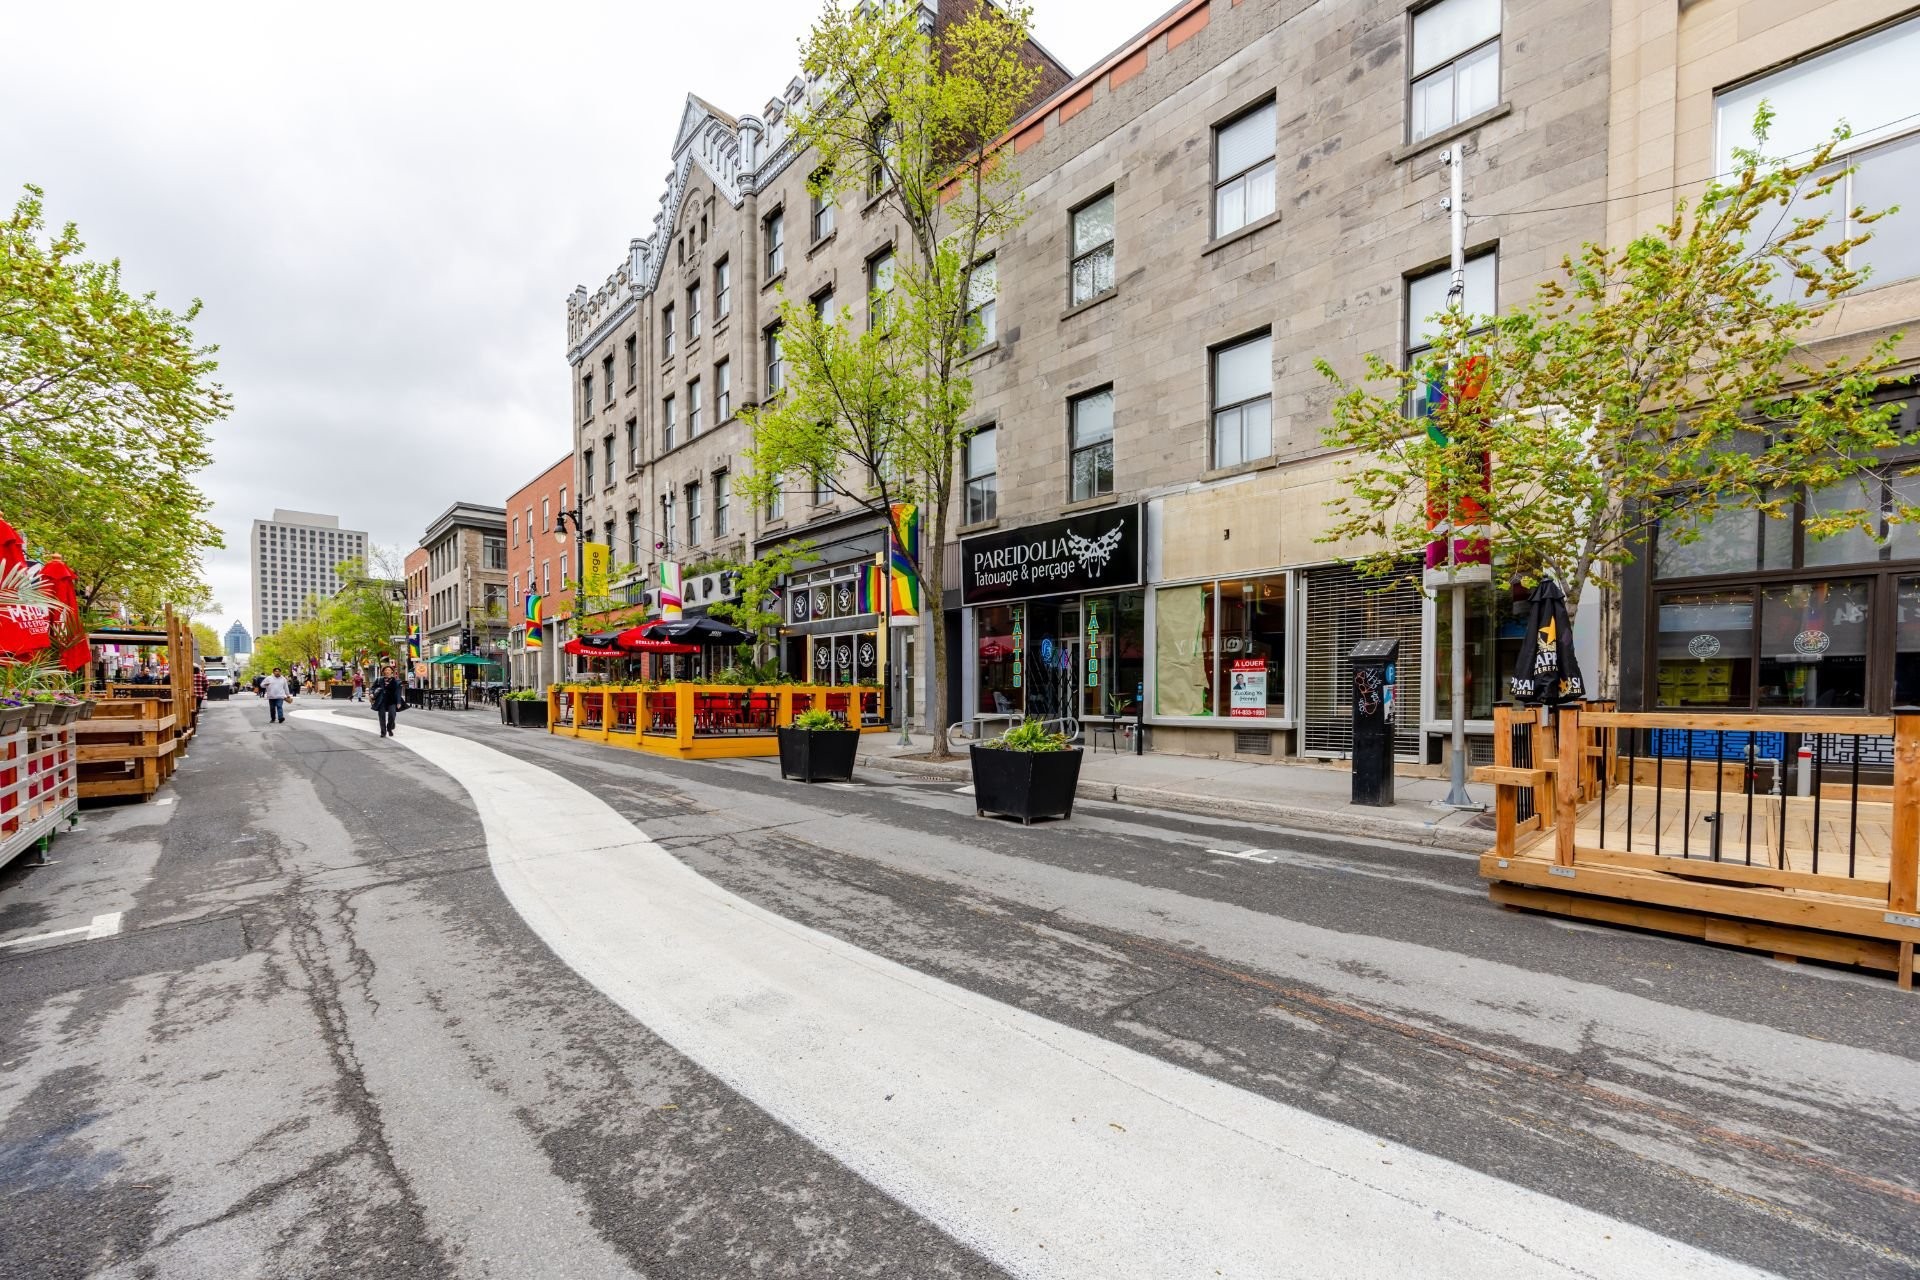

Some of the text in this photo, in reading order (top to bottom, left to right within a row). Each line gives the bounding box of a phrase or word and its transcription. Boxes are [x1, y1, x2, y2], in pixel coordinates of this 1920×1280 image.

[974, 537, 1070, 572] PAREIDOLIA
[974, 560, 1075, 587] Tatouage & perçage
[1012, 608, 1022, 688] TATTOO
[1087, 601, 1099, 687] TATTOO
[1241, 660, 1264, 668] LOUER
